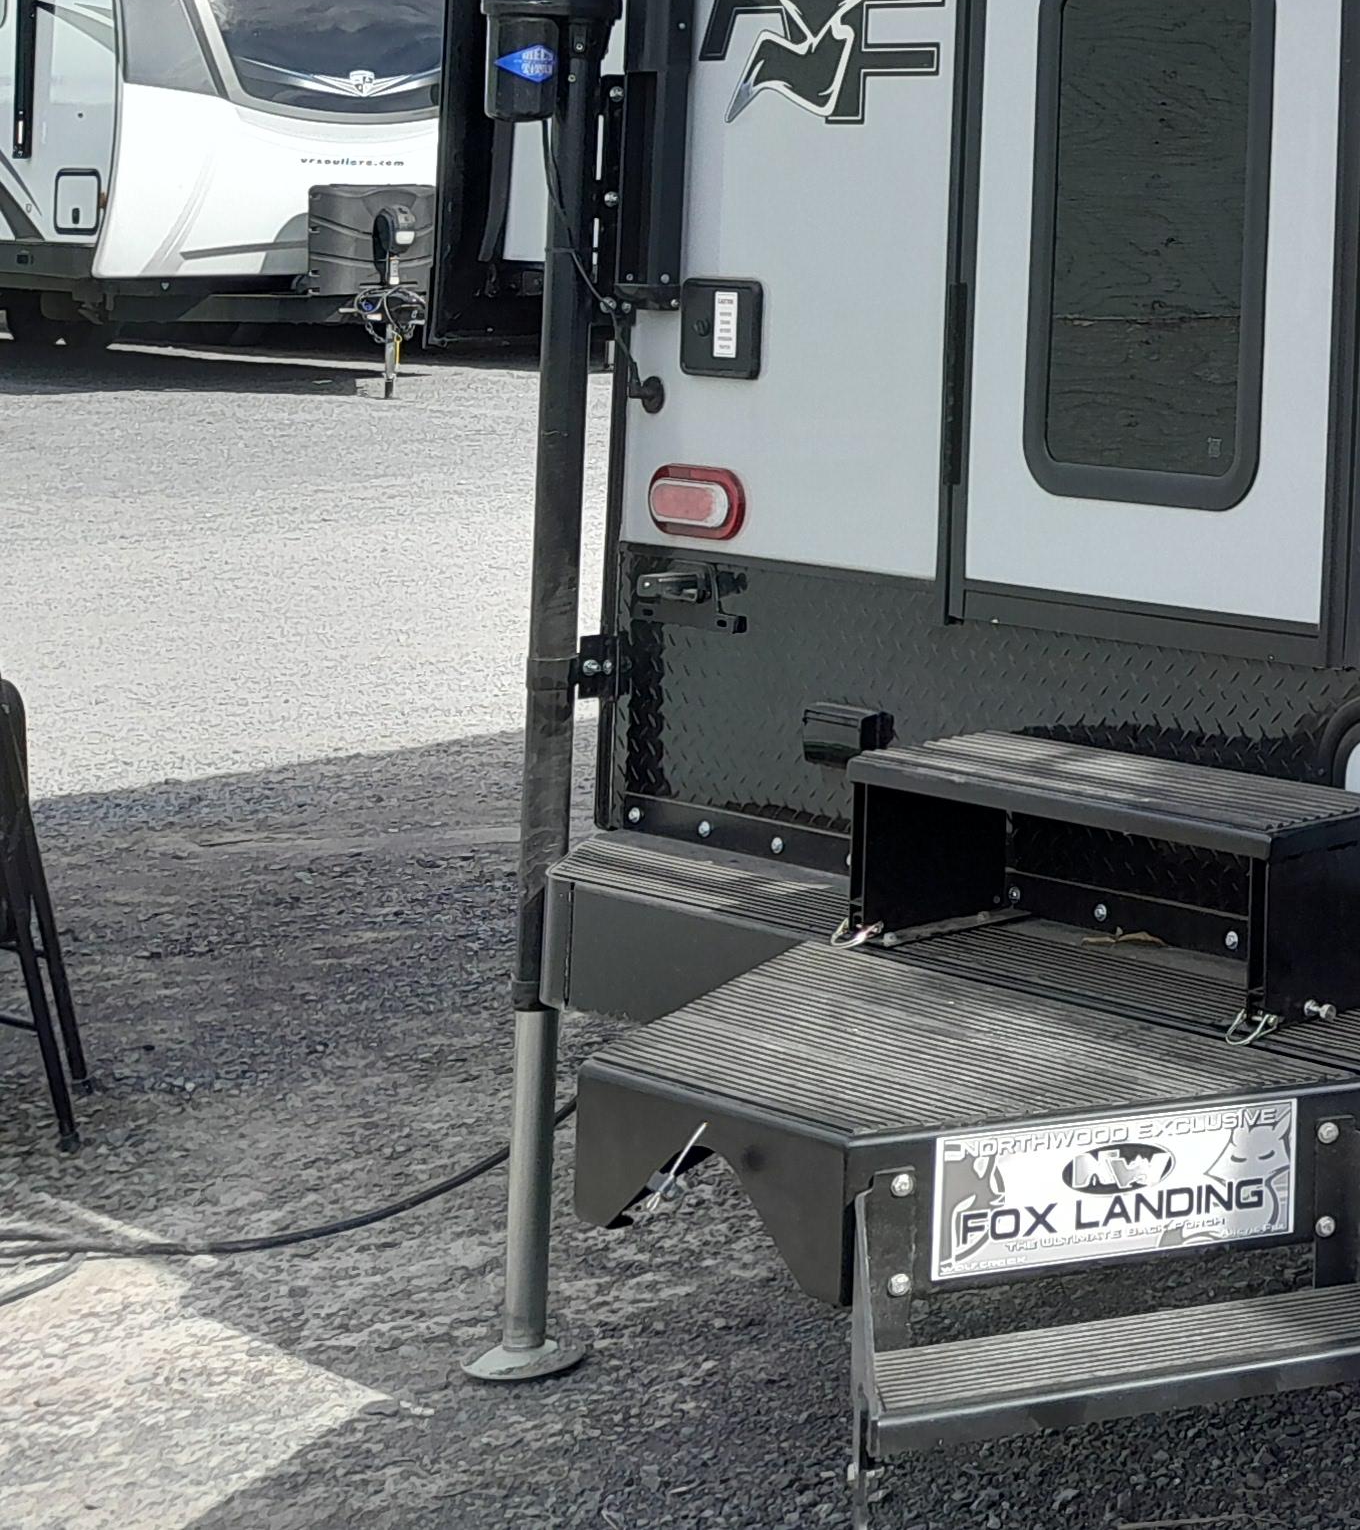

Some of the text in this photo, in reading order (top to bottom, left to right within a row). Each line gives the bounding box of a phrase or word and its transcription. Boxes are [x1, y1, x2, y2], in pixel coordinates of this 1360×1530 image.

[959, 1108, 1278, 1158] NORTHWOOD EXCLUSIVE
[961, 1177, 1265, 1245] FOX LANDING
[1041, 1227, 1123, 1250] ULTIMATE
